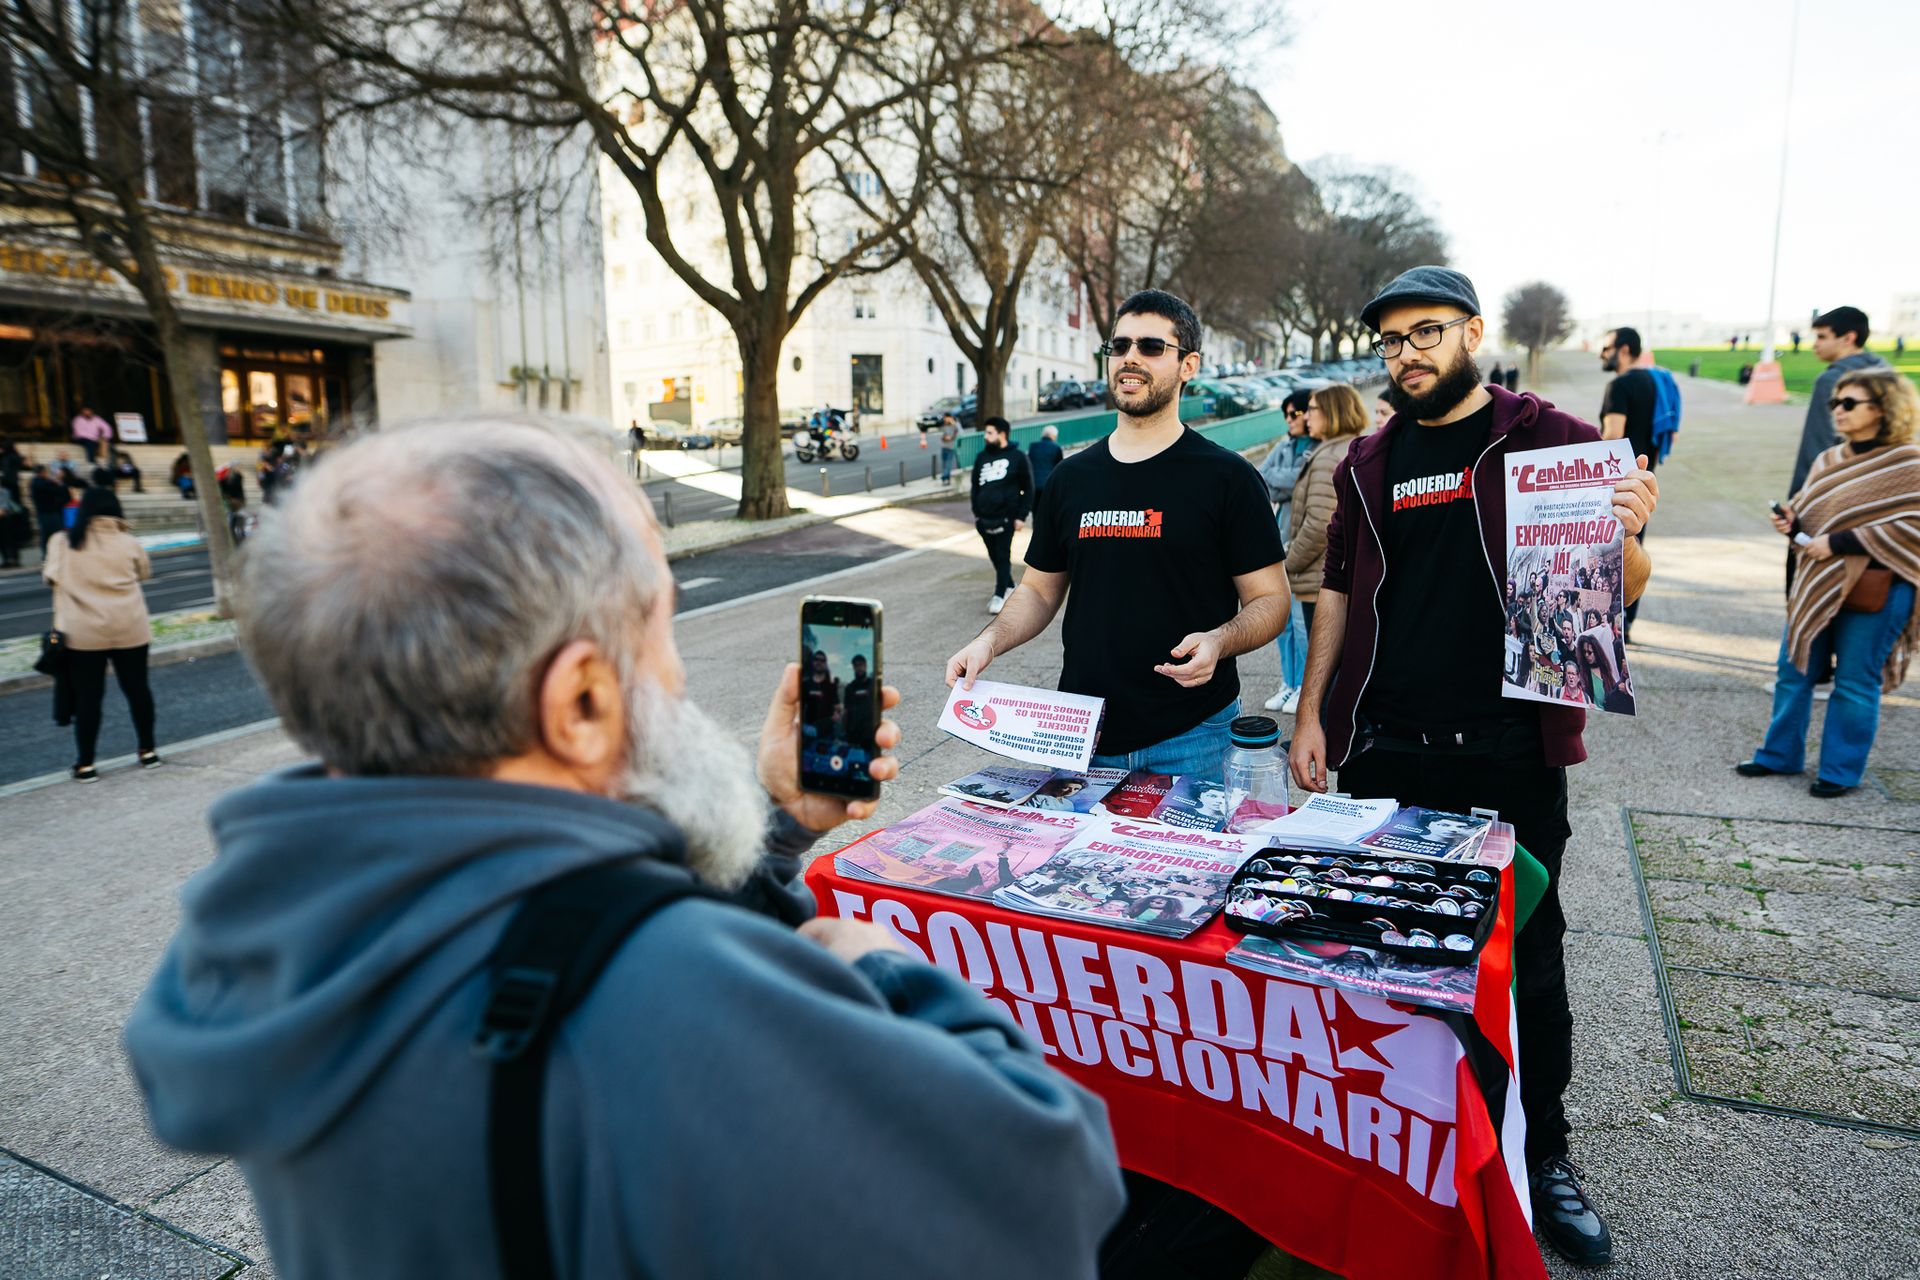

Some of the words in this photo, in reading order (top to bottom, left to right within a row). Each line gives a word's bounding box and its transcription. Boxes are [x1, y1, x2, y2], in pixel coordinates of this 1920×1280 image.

[186, 272, 278, 305] REINO
[285, 284, 318, 309] DE
[325, 289, 390, 319] DEUS
[1512, 466, 1519, 477] A
[1517, 458, 1604, 493] Centelha
[1393, 472, 1464, 501] ESQUERDA
[1080, 510, 1145, 528] ESQUERDA
[1515, 516, 1617, 549] EXPROPRIAÇÃO
[1552, 547, 1571, 575] JÁ!
[1014, 708, 1028, 717] OS
[1029, 710, 1090, 724] EXPROPRIAR
[1053, 705, 1092, 717] FUNDOS
[1036, 720, 1080, 733] URGENTE
[1002, 733, 1052, 747] duramente
[1053, 741, 1084, 751] atinge
[1037, 746, 1048, 754] da
[1050, 748, 1074, 758] crise
[1076, 751, 1083, 760] A
[1161, 810, 1216, 828] feminismo
[1165, 806, 1196, 819] Escritos
[1197, 815, 1219, 824] sobre
[1111, 824, 1224, 847] Centelha
[1376, 836, 1442, 851] feminismo
[1087, 840, 1237, 874] EXPROPRIAÇÃO
[1133, 859, 1166, 874] JÁ!
[1251, 953, 1321, 975] SOLIDARIEDADE
[1322, 969, 1344, 981] COM
[1354, 977, 1381, 989] POVO
[1382, 982, 1454, 1000] PALESTINIANO
